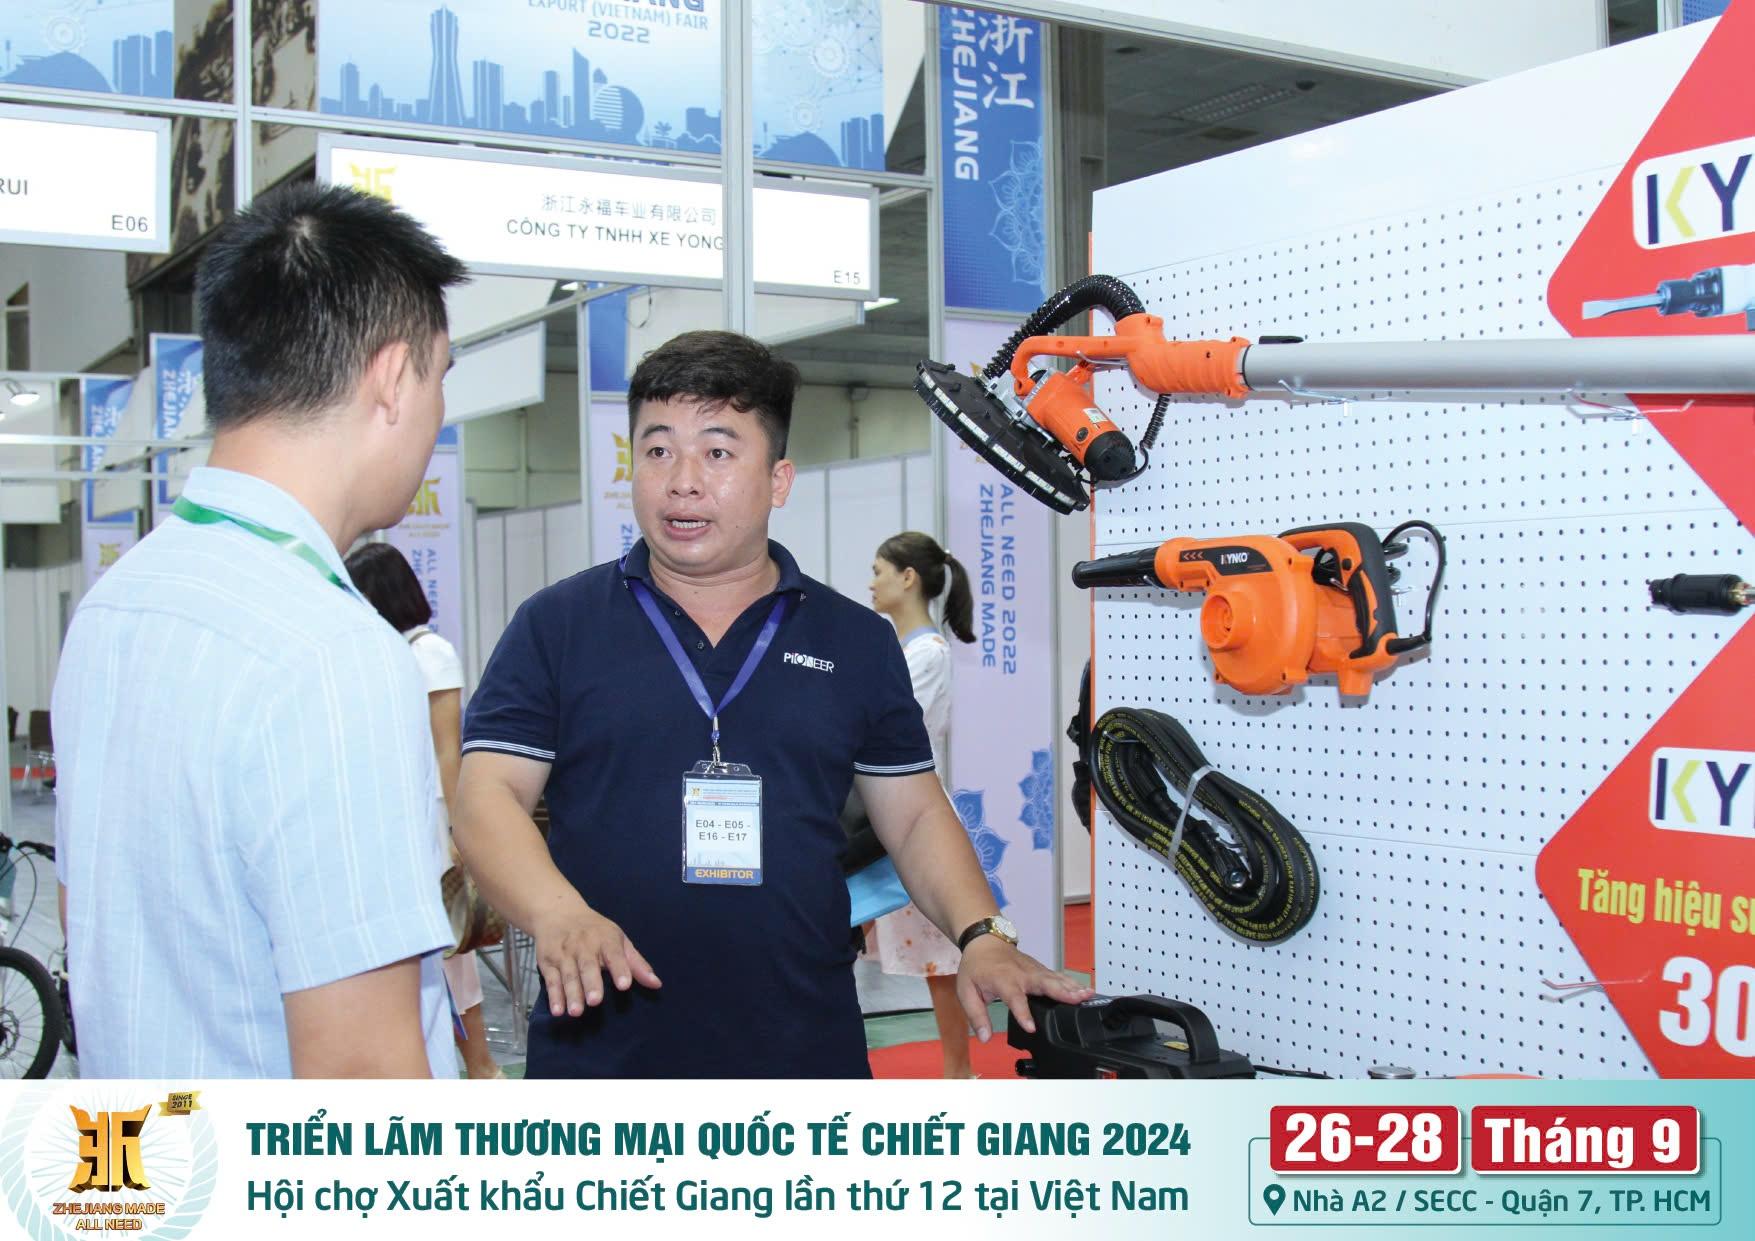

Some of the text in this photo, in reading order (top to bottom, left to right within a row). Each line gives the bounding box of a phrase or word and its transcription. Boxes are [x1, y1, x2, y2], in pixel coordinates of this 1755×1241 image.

[588, 20, 650, 43] 2022
[675, 12, 708, 30] FAIR
[978, 14, 1035, 109] 浙江
[543, 194, 717, 226] 浙江永福车业有限公司
[111, 215, 148, 232] E06
[507, 217, 560, 237] CÔNG
[568, 224, 588, 239] TY
[595, 226, 642, 243] TNHH
[649, 232, 670, 245] XE
[833, 270, 861, 285] E15
[980, 484, 996, 667] ZHEJIANG MADE
[1001, 484, 1016, 675] ALL NEED 2022
[695, 820, 715, 829] E04
[725, 820, 744, 829] E05
[699, 832, 718, 841] E16
[728, 832, 747, 841] E17
[695, 868, 754, 879] EXHIBITOR
[1578, 868, 1646, 924] Tăng
[1654, 878, 1721, 936] hiệu
